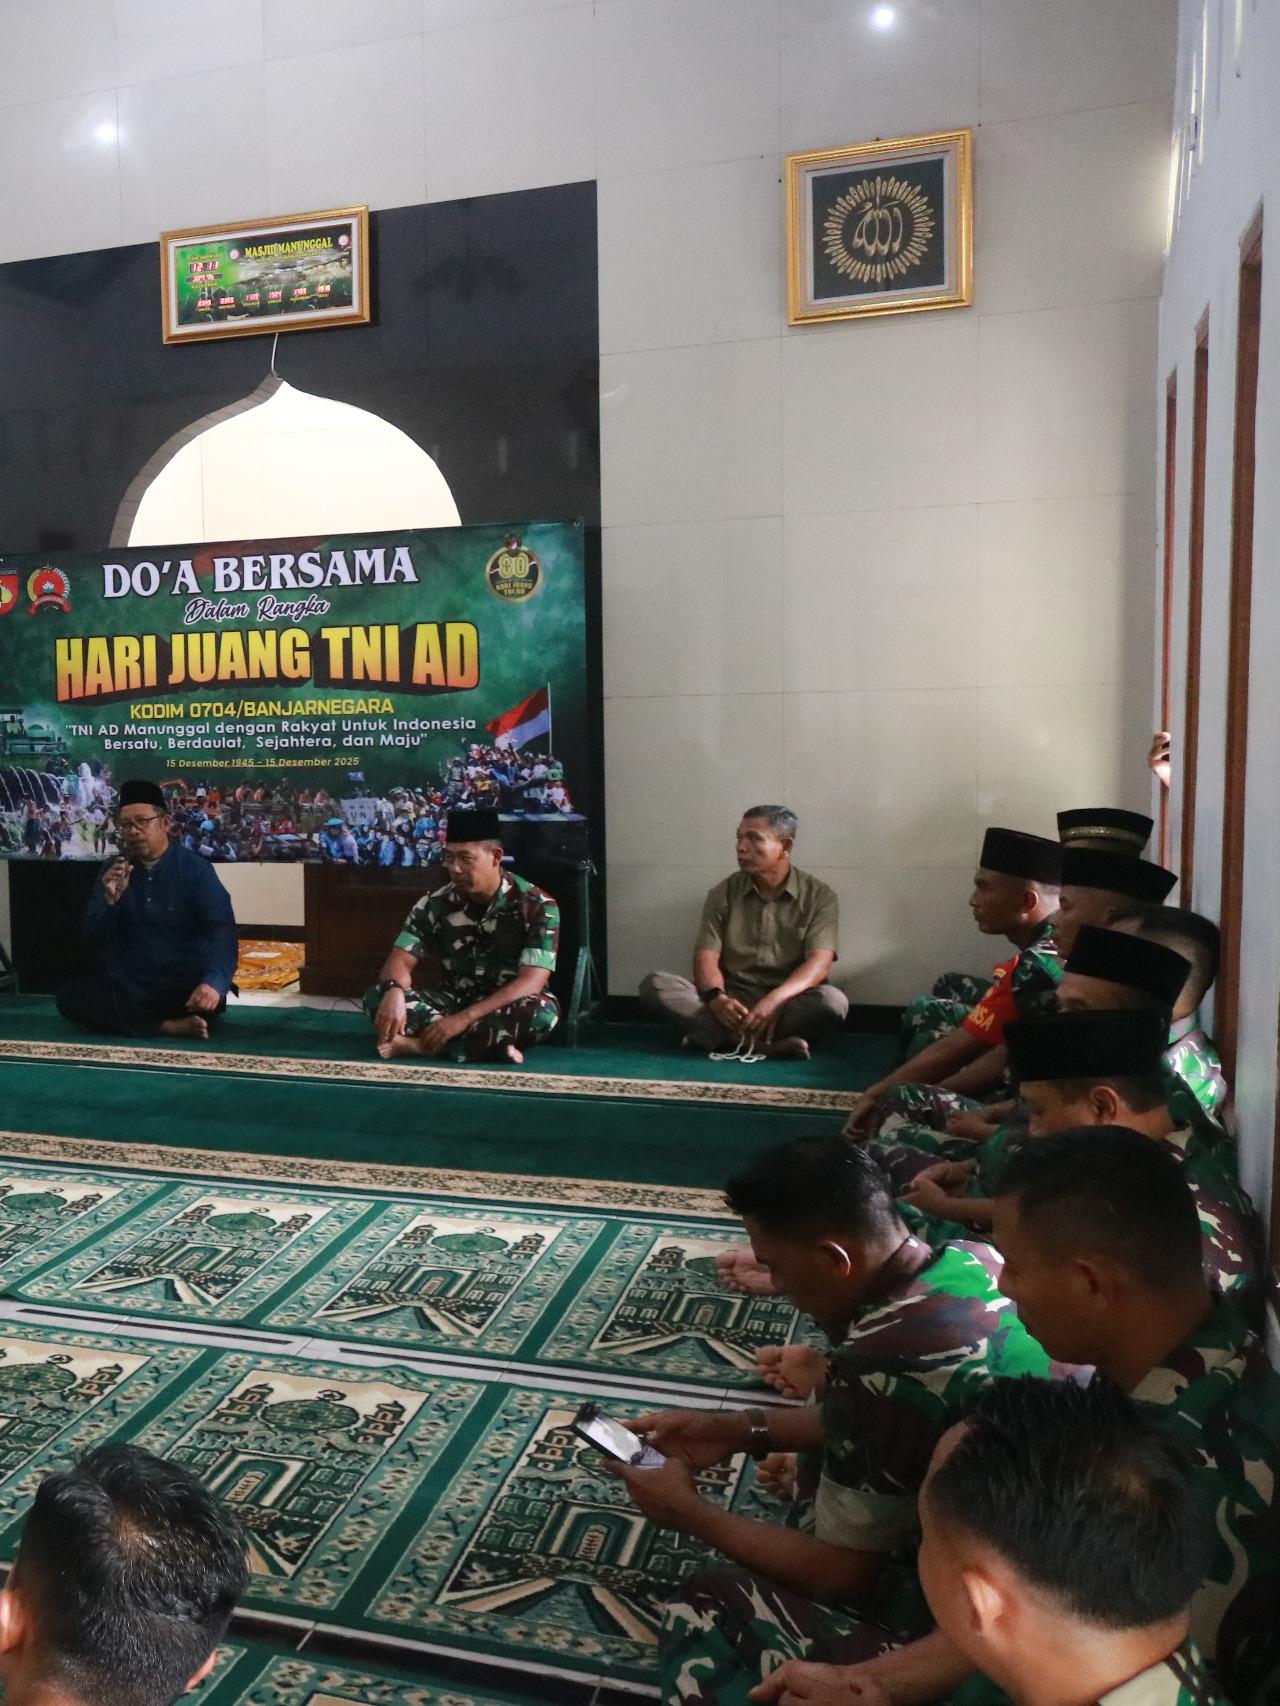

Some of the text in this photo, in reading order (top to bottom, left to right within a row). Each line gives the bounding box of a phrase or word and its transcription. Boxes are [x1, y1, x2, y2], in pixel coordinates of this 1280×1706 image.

[245, 242, 277, 258] MASJID
[279, 236, 333, 254] MANUNGGAL
[102, 546, 419, 598] DO'A BERSAMA
[498, 552, 530, 579] 80
[184, 594, 330, 625] Dalam Rangka
[56, 622, 479, 702] HARI JUANG TNI AD
[130, 698, 395, 719] KODIM 0704/BANJARNEGARA
[65, 716, 476, 737] "TNI AD Manunggal dengan Rakyat Untuk Indonesia
[104, 733, 428, 750] Bersatu, Berdaulat, Sejahtera, dan Maju"
[166, 759, 176, 768] 15
[178, 758, 230, 768] Desember
[231, 758, 255, 768] 1945
[265, 758, 276, 767] 15
[278, 757, 332, 768] Desember
[334, 756, 360, 767] 2025
